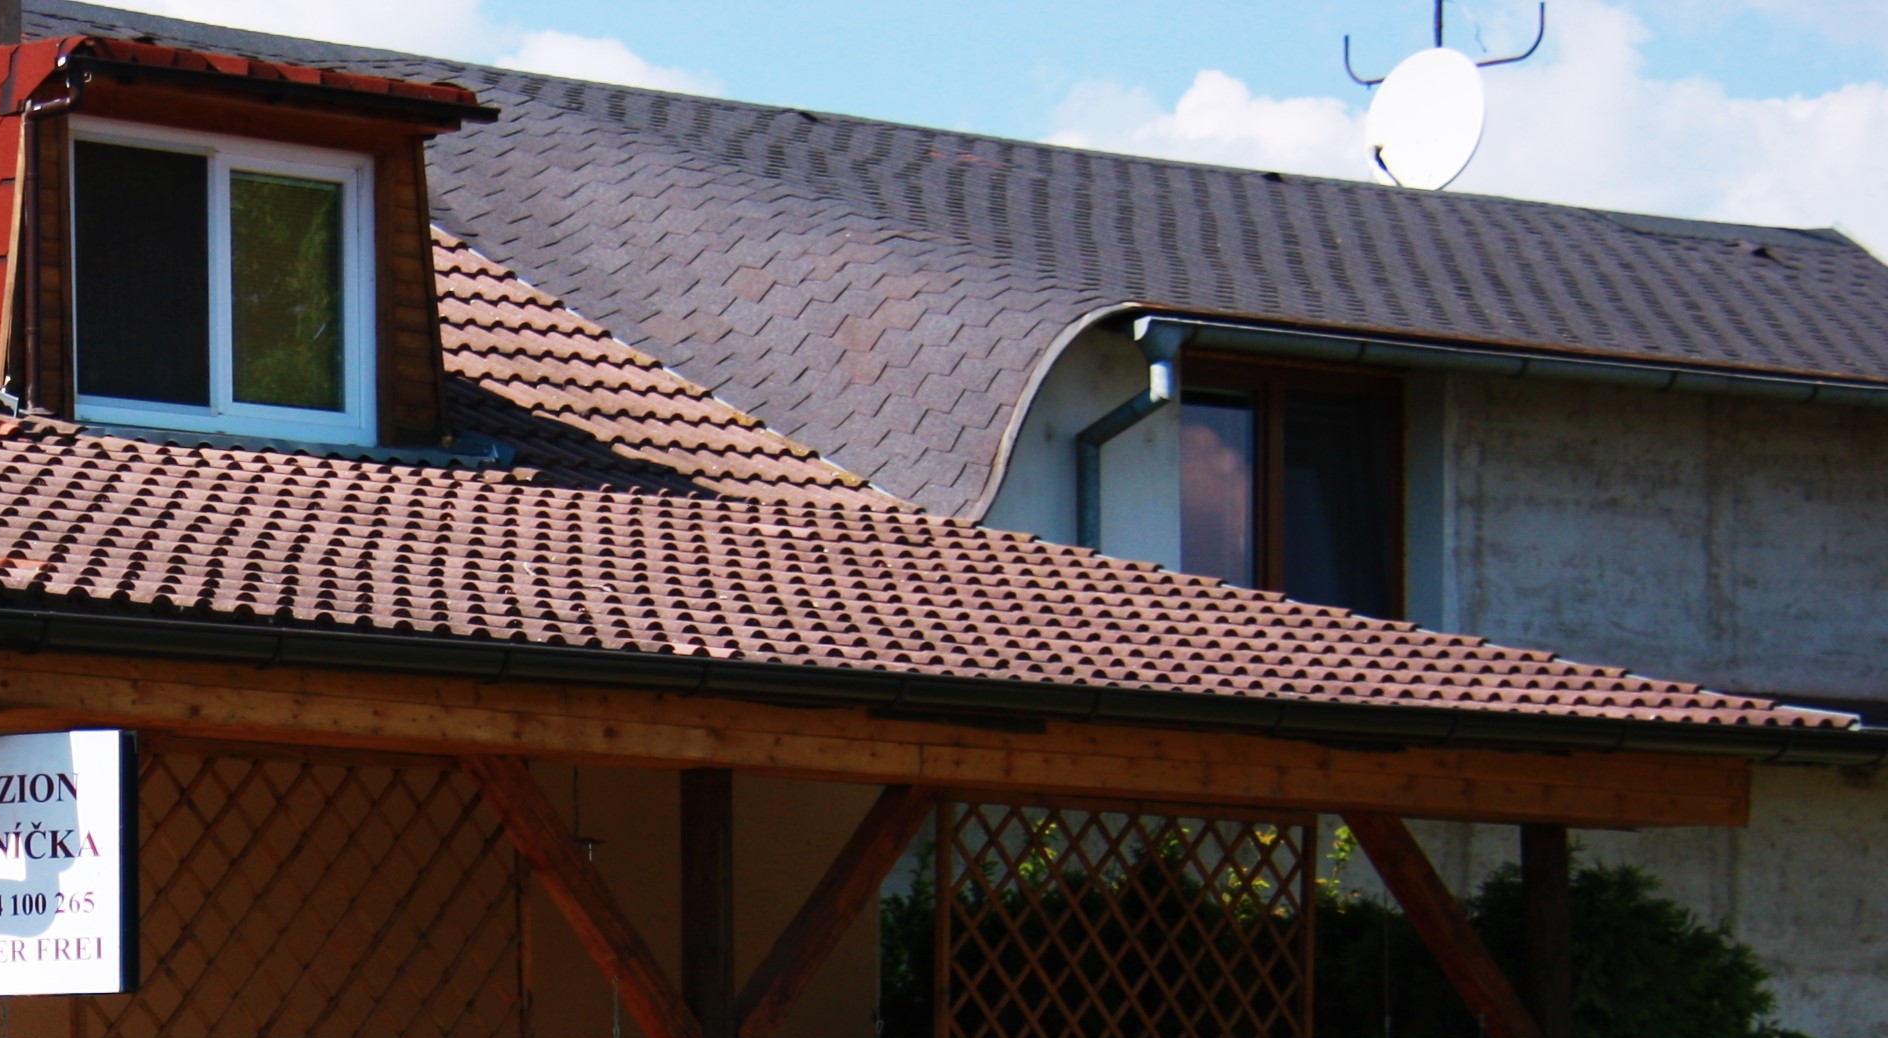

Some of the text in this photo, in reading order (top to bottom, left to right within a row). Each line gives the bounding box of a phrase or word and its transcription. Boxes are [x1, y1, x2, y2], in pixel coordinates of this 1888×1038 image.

[10, 892, 47, 917] 100
[54, 890, 96, 915] 265
[36, 936, 105, 962] FREI
